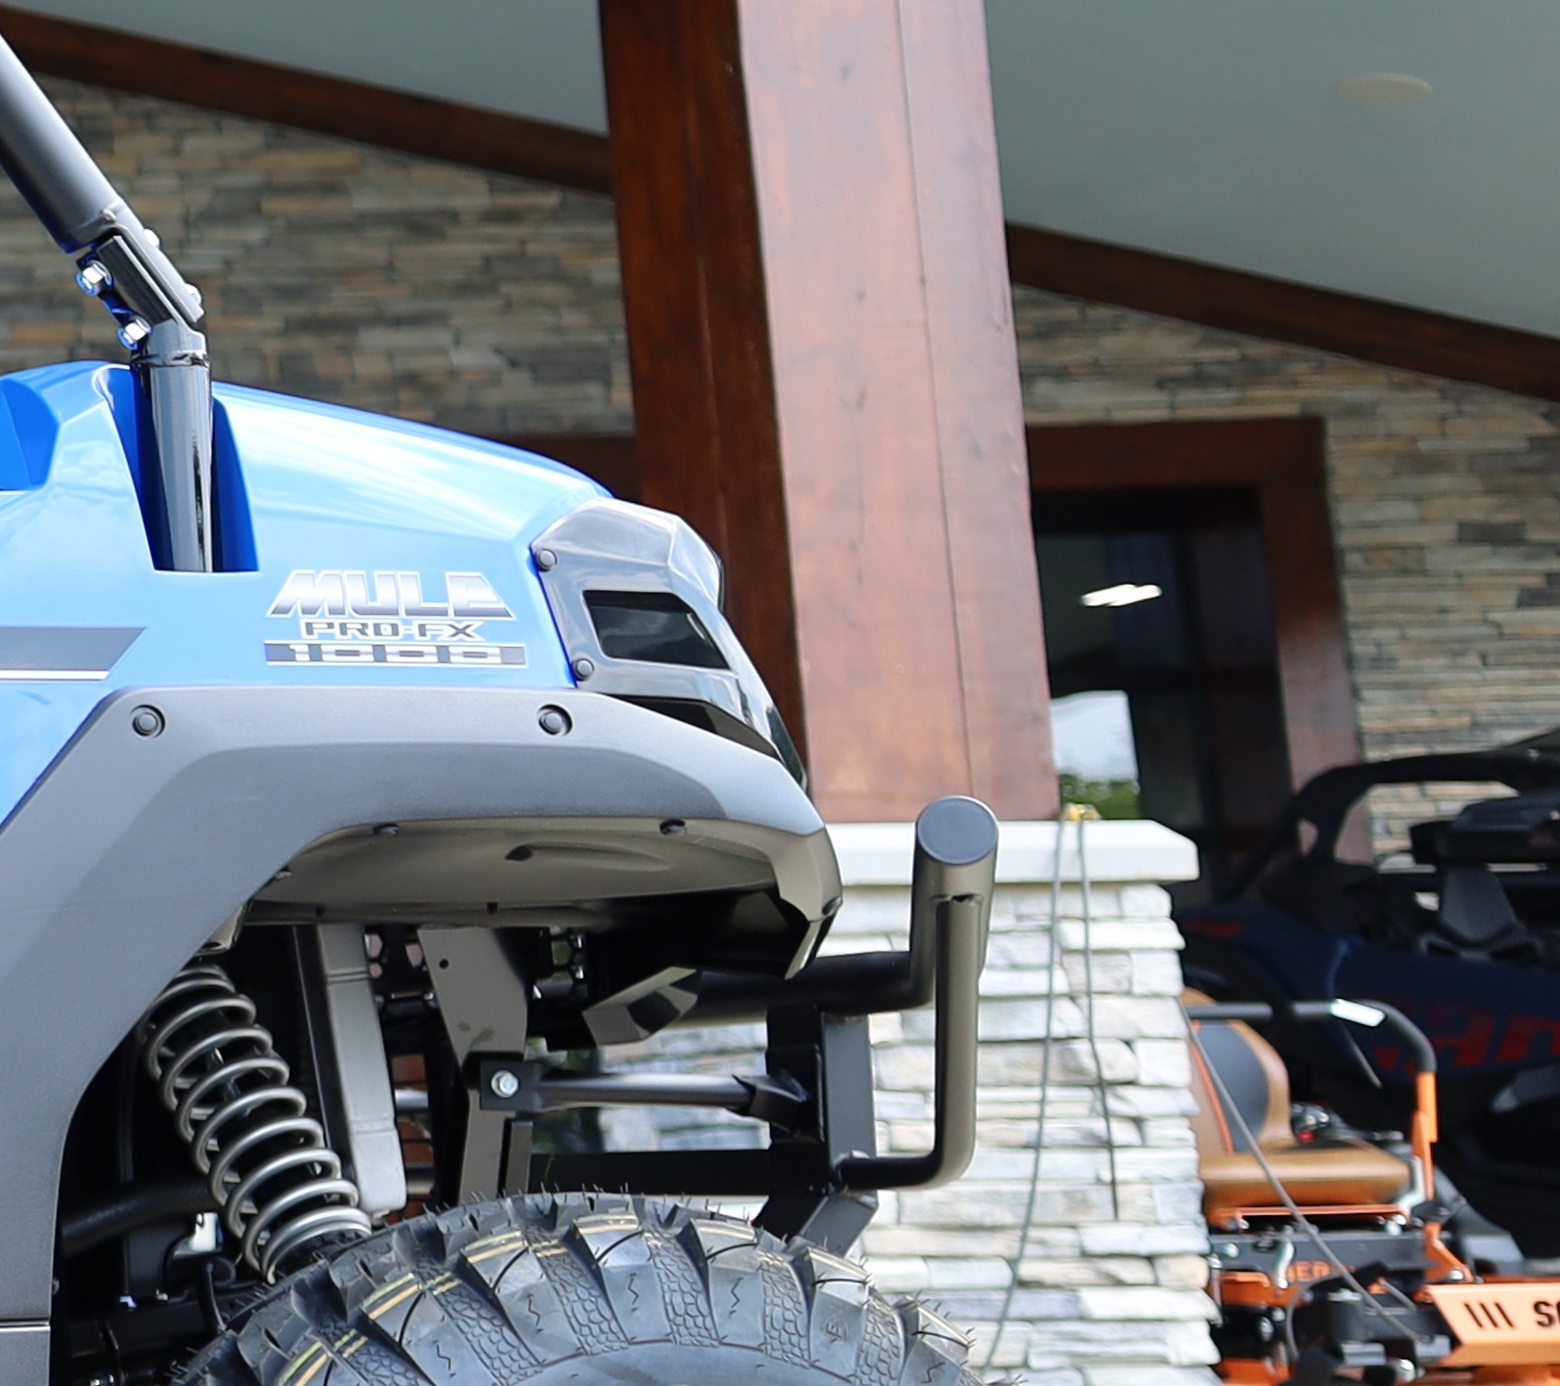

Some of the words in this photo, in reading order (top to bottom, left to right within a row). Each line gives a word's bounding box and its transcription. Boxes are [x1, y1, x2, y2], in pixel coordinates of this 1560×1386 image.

[265, 569, 517, 620] MULE
[300, 620, 487, 641] PRO-FX
[288, 642, 504, 664] 1000
